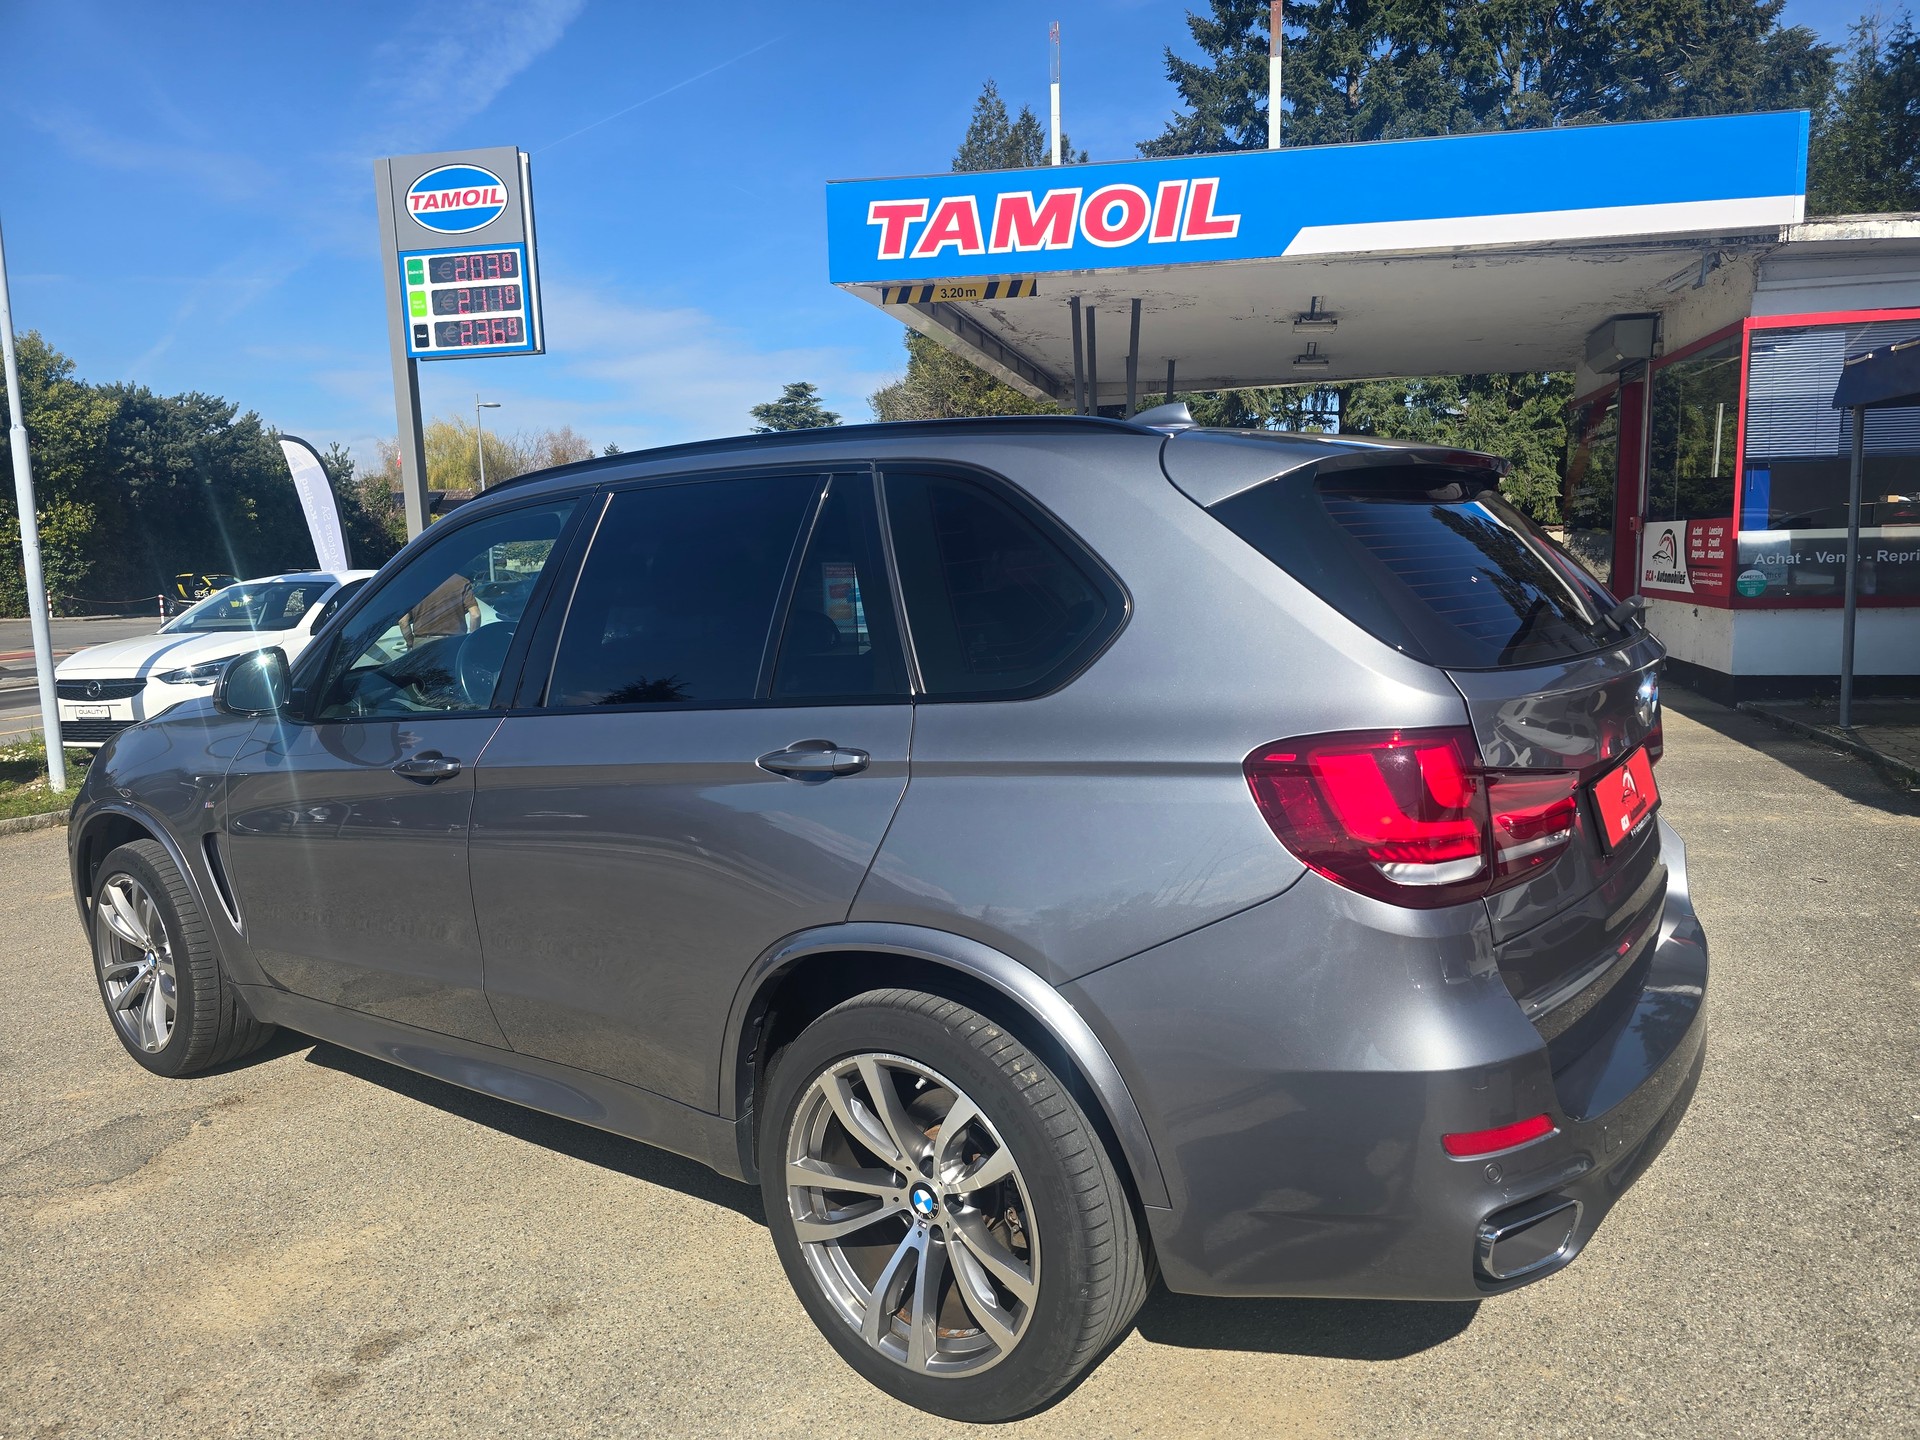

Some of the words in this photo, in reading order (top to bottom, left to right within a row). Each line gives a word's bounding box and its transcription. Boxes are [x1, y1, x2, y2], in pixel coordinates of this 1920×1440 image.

[410, 188, 504, 211] TAMOIL
[867, 177, 1241, 260] TAMOIL
[940, 287, 964, 299] 3.20
[965, 288, 977, 298] m
[1754, 552, 1800, 565] Achat
[1815, 551, 1861, 564] Ven
